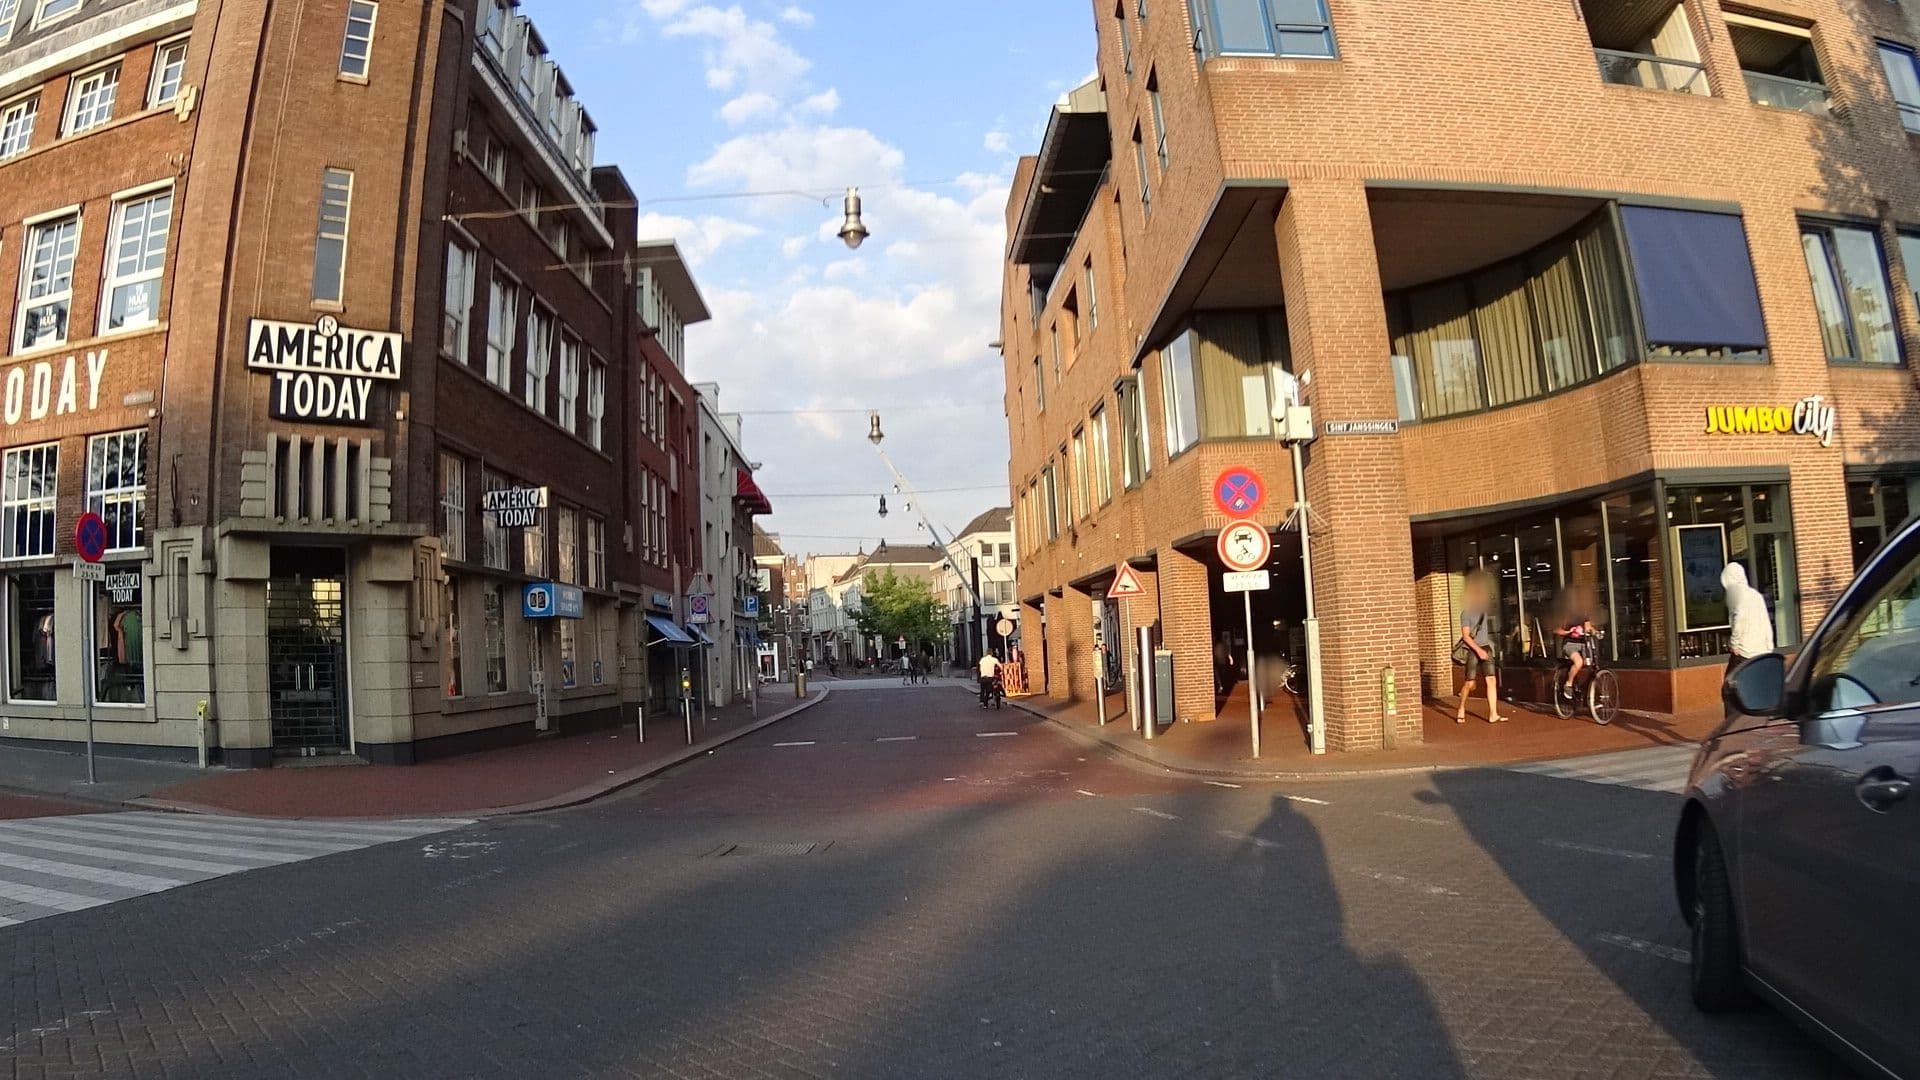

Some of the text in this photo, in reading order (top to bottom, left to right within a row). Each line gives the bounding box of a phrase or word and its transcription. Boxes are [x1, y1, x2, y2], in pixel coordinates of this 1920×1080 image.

[252, 325, 396, 374] AMERICA
[0, 349, 108, 425] ODAY
[276, 371, 372, 421] TODAY
[1329, 422, 1346, 434] SINT
[1705, 394, 1835, 447] JUMBO City
[488, 490, 545, 508] AMERICA
[498, 508, 536, 527] TODAY
[107, 574, 138, 588] AMERICA
[112, 589, 133, 603] TODAY
